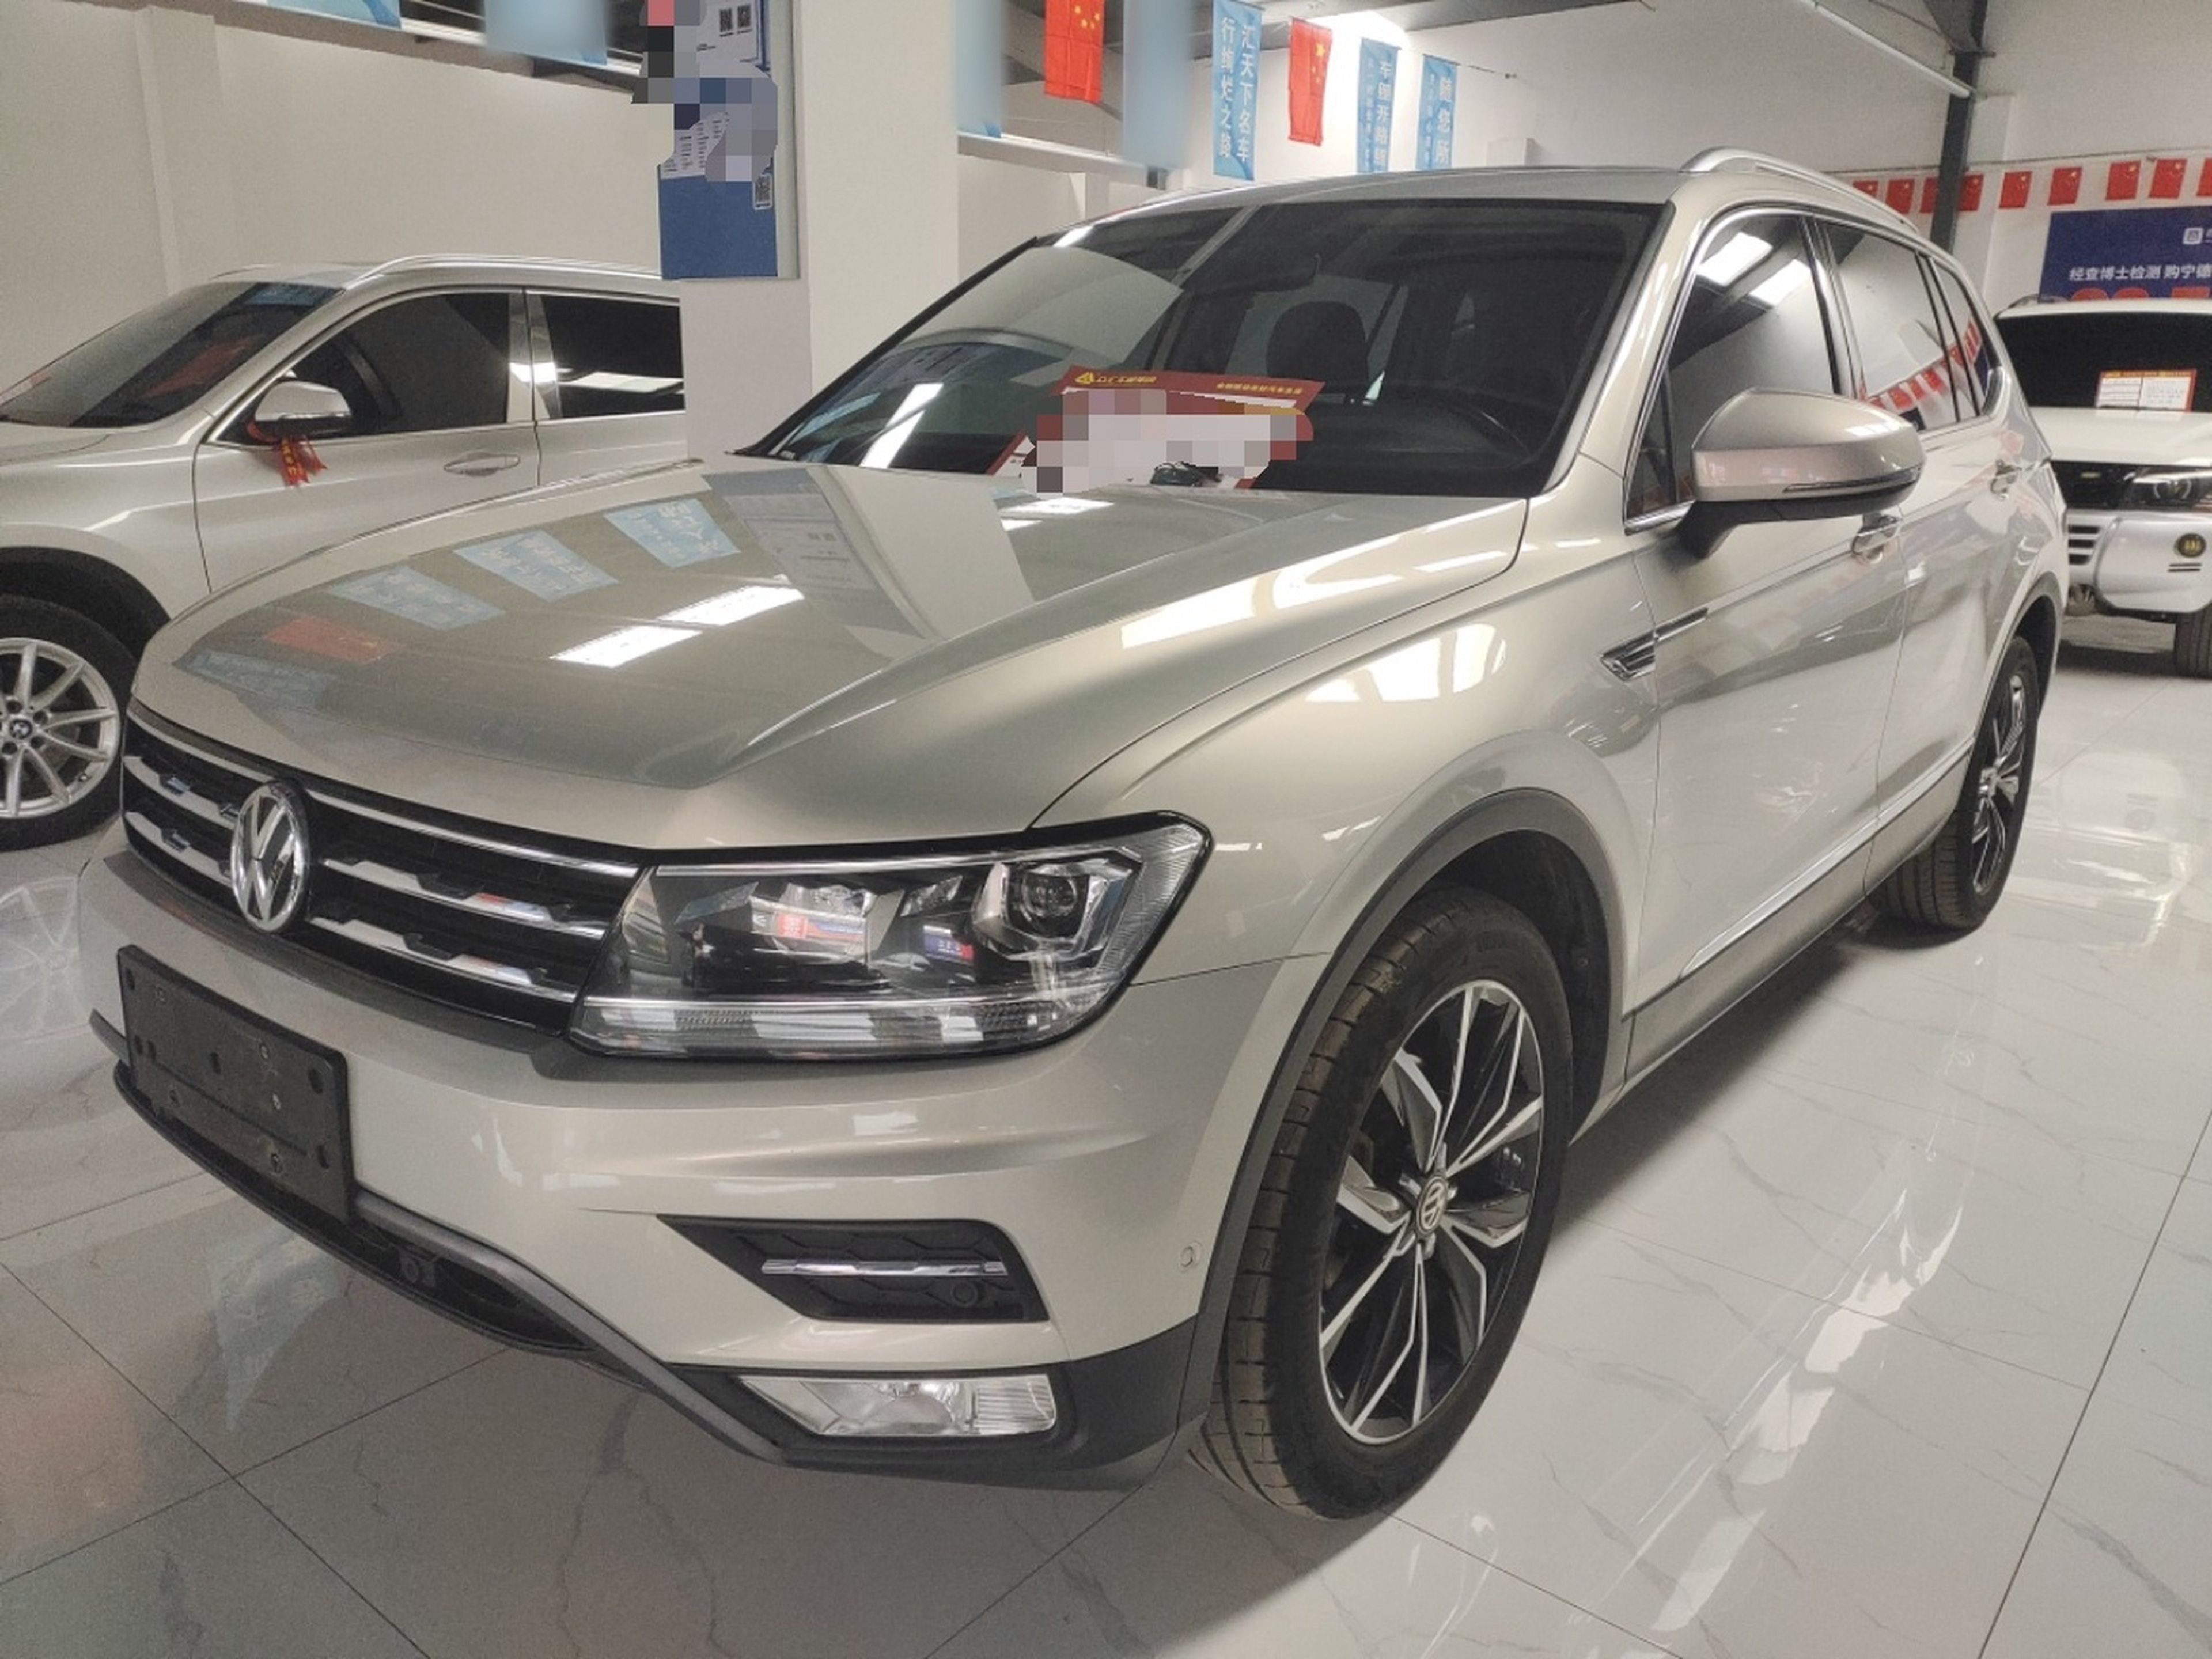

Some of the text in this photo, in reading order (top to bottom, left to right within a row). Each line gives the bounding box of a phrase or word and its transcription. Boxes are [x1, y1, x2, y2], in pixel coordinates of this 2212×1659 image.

[1236, 24, 1256, 163] 汇天下名车
